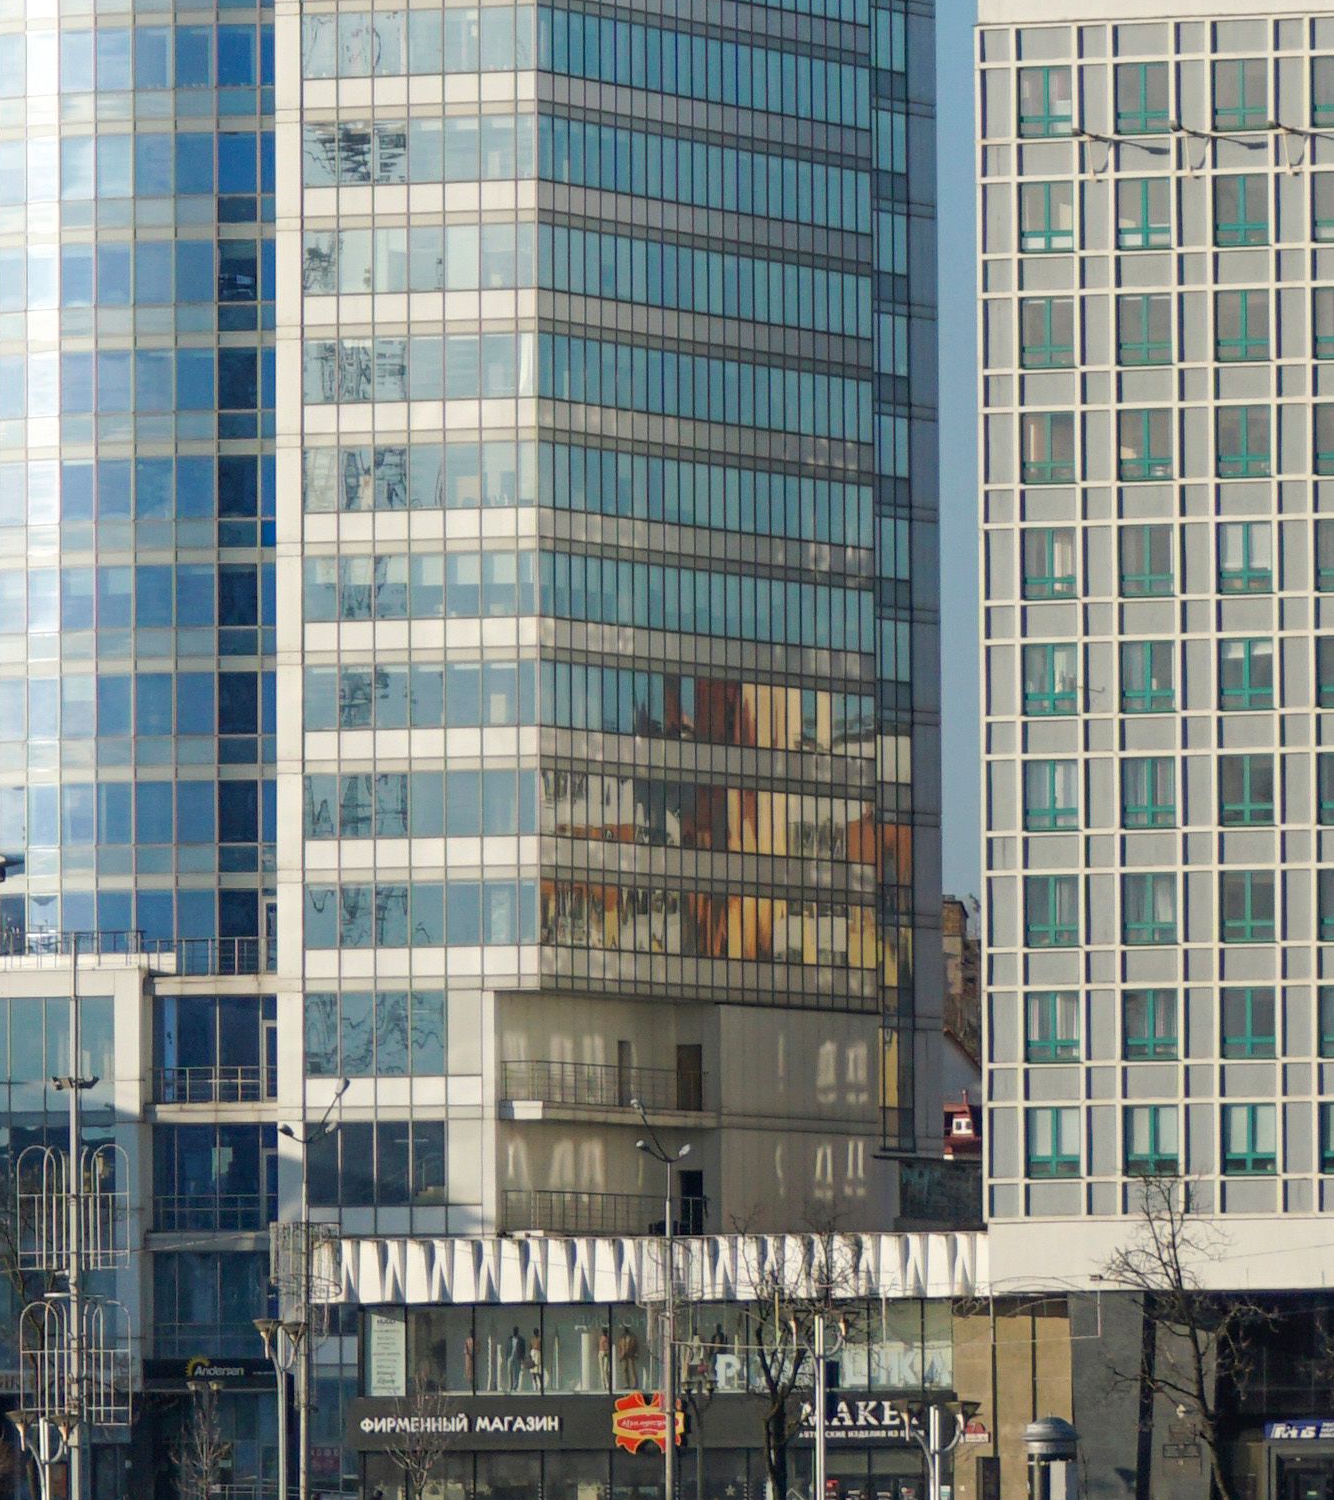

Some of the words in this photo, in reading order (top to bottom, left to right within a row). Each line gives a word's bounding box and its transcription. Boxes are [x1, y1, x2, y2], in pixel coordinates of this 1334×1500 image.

[194, 1365, 244, 1377] Andersen
[360, 1413, 469, 1433] ФИРМЕННЫЙ
[475, 1415, 560, 1433] МАГАЗИН
